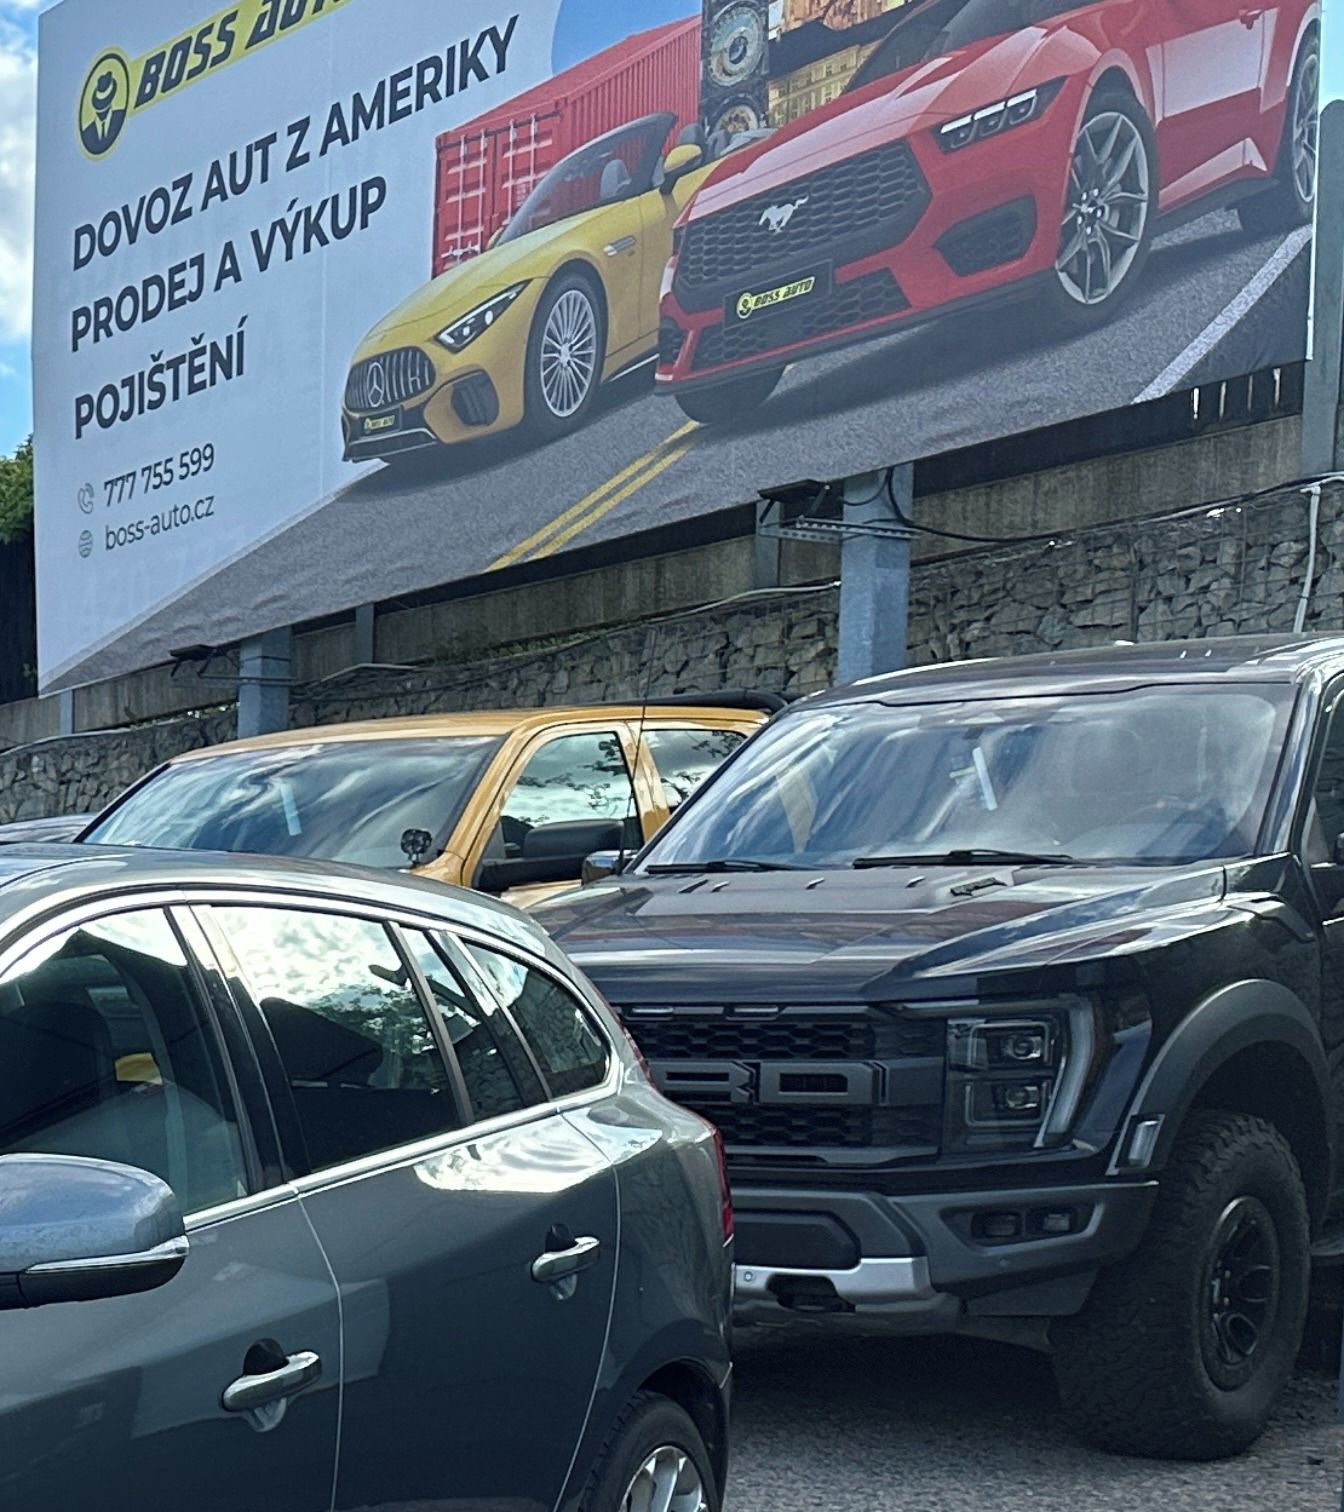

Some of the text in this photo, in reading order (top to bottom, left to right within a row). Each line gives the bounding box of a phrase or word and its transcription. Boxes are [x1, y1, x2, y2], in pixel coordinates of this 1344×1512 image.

[134, 0, 343, 109] BOSS AU
[73, 15, 520, 271] DOVOZ AUT Z AMERIKY
[71, 176, 387, 353] PRODEJ A VÝKUP
[75, 314, 248, 439] POJIŠTĚNÍ
[103, 443, 215, 507] 777 755 599
[105, 495, 215, 551] boss-auto.cz
